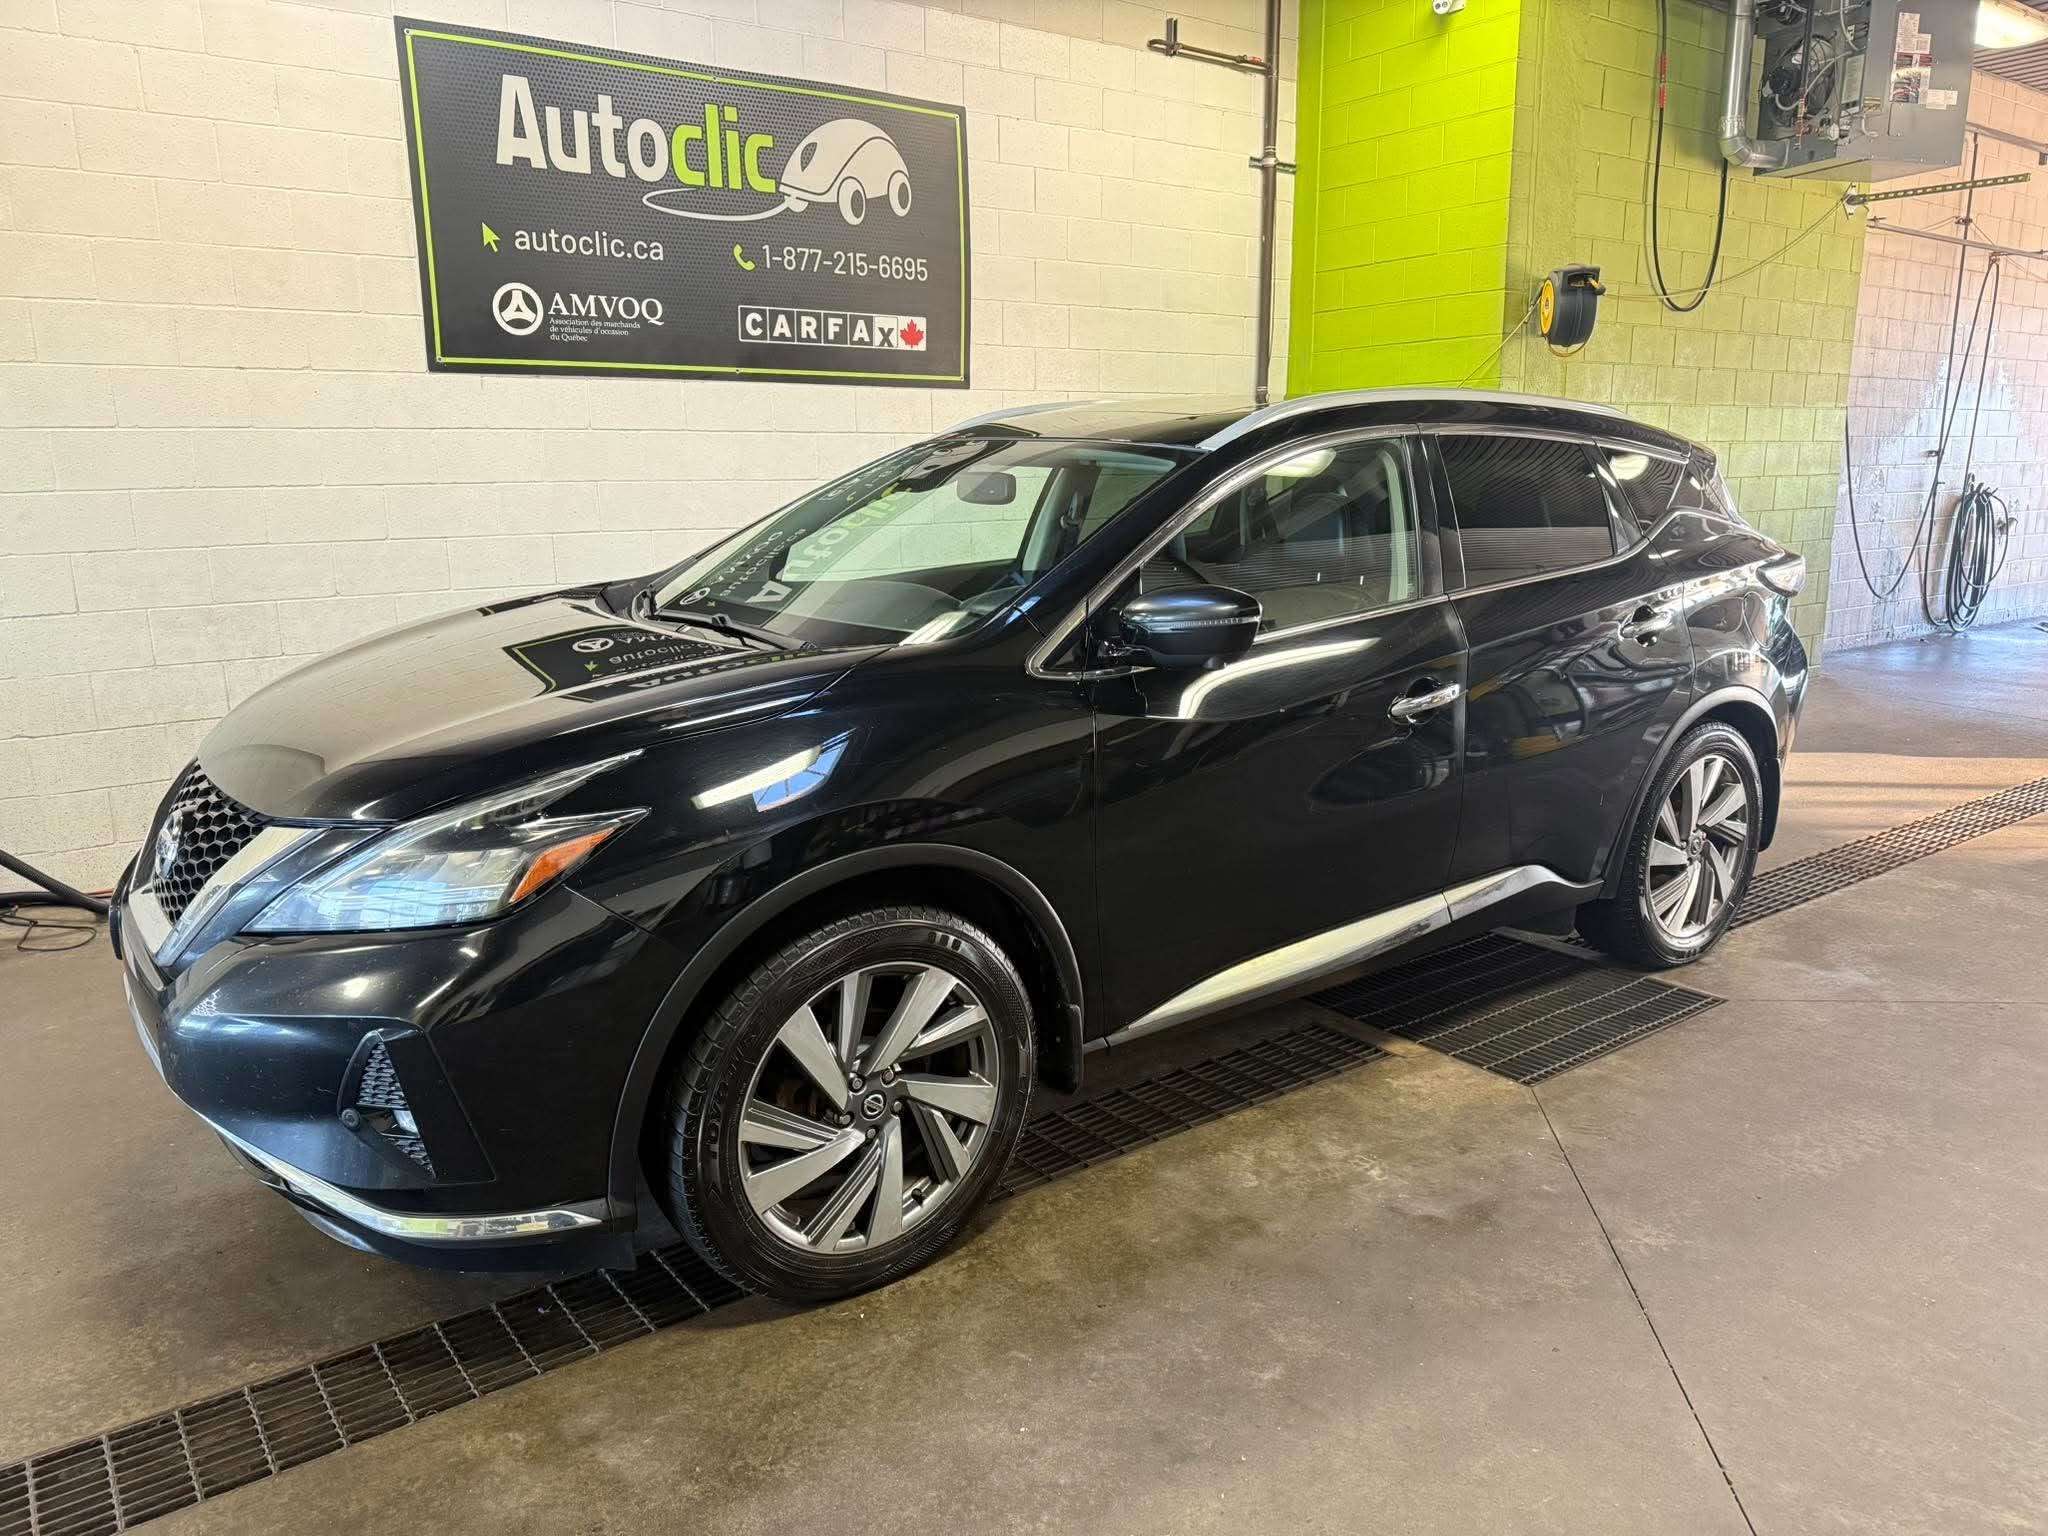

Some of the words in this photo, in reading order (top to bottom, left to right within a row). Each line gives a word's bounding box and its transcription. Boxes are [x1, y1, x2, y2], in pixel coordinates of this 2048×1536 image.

[496, 74, 776, 193] Autoclic
[514, 228, 664, 261] autoclic.ca
[762, 244, 928, 281] 1-877-215-6695
[548, 292, 664, 326] AMVOQ
[549, 317, 590, 327] Association
[604, 321, 641, 329] marchands
[549, 325, 559, 333] de
[550, 333, 560, 341] du
[744, 311, 894, 347] CARFAX
